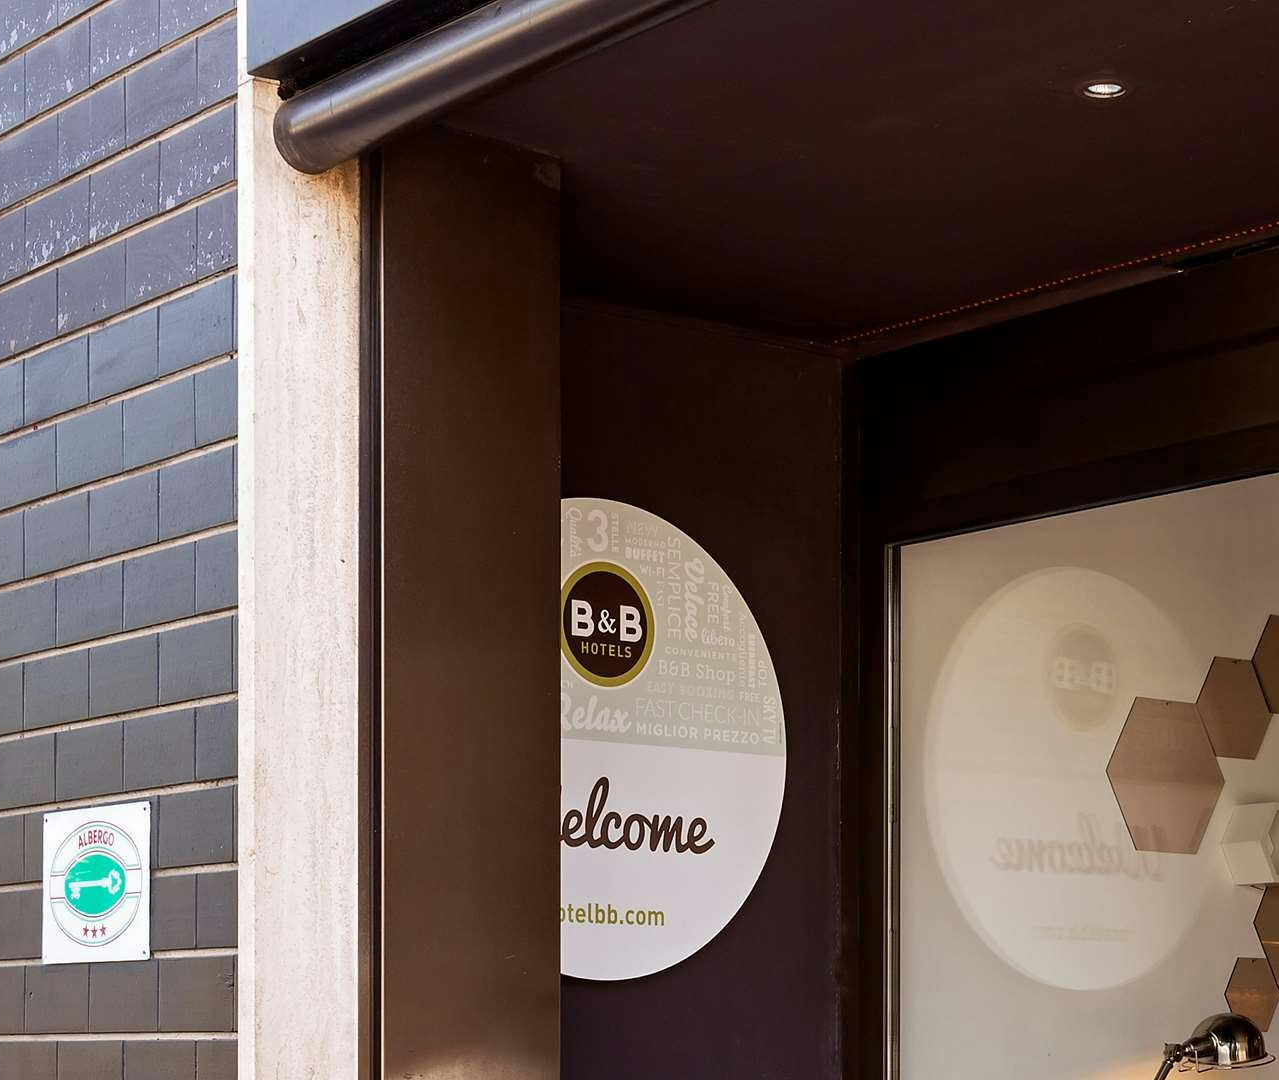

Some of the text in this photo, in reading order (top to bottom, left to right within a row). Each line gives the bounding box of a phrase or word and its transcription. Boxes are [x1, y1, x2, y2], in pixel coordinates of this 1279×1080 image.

[587, 509, 609, 552] 3
[624, 547, 665, 563] BUFFET
[639, 564, 665, 579] WI-FI
[667, 536, 681, 641] SEMPLICE
[707, 581, 720, 625] FREE
[571, 599, 643, 643] B&B
[581, 641, 632, 658] HOTELS
[665, 646, 737, 661] CONVENIENTE
[658, 659, 736, 686] B&B Shop
[635, 698, 760, 728] FAST CHECK-IN
[763, 696, 777, 744] SKY TV
[636, 723, 760, 744] MIGLIOR PREZZO
[560, 777, 715, 855] elcome
[78, 829, 115, 849] ALBERGO
